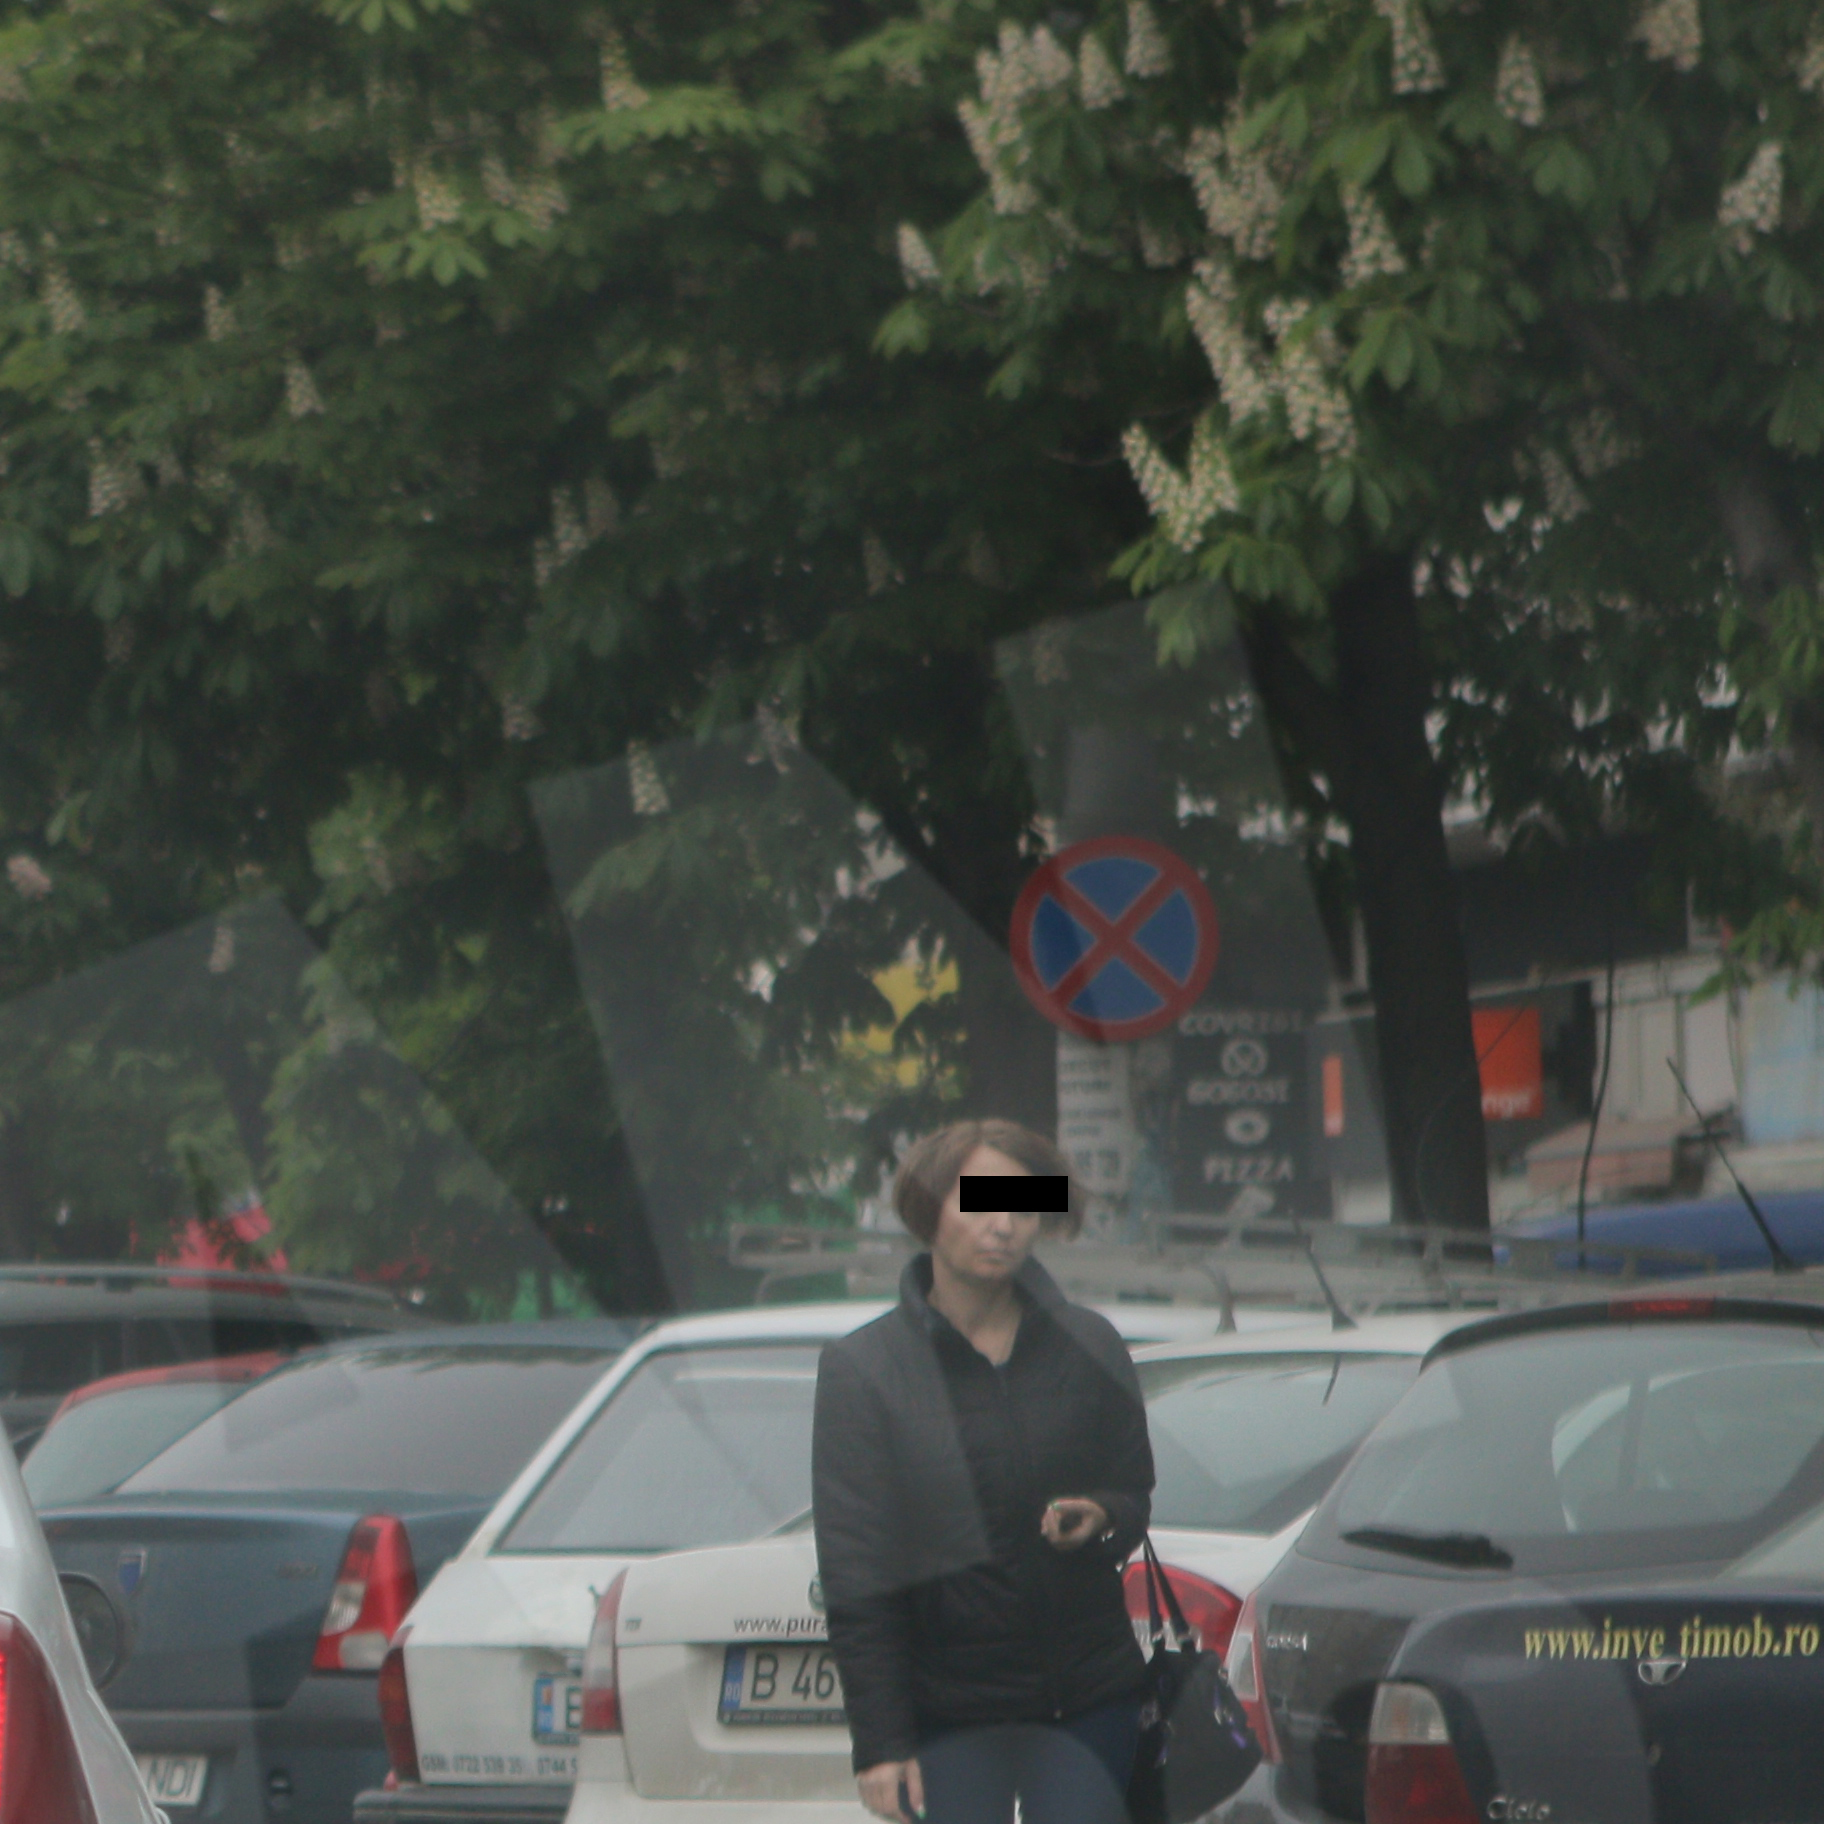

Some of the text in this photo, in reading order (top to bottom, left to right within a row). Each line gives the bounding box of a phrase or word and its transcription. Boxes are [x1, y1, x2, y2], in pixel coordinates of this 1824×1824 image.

[1203, 1153, 1295, 1184] PIZZA
[752, 1652, 779, 1702] B
[792, 1652, 836, 1702] 46
